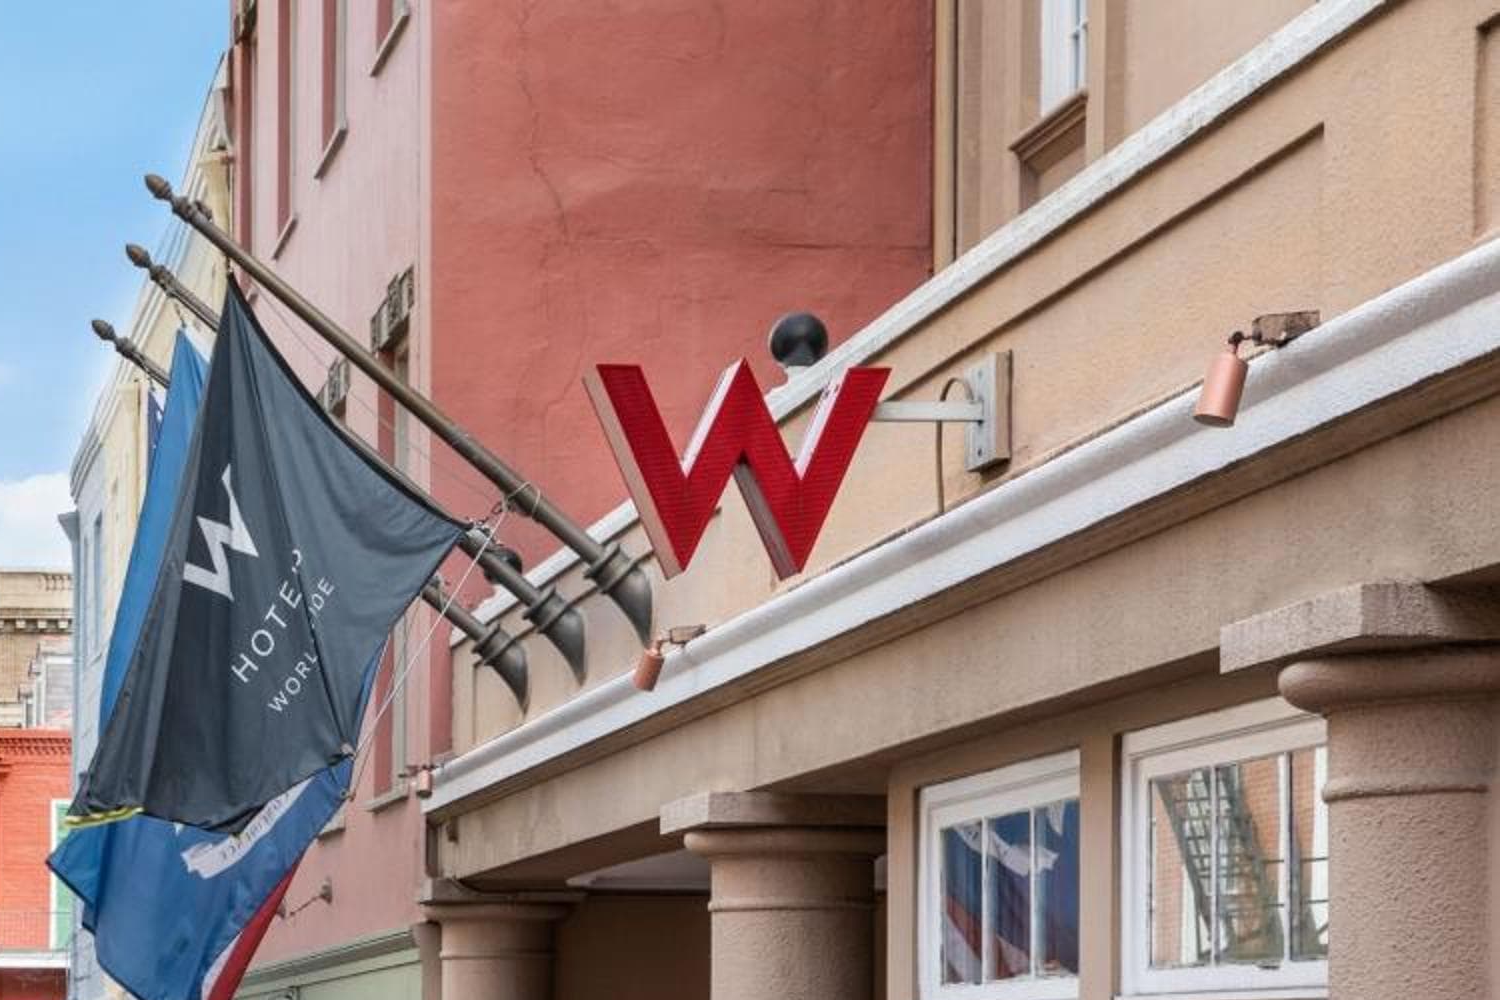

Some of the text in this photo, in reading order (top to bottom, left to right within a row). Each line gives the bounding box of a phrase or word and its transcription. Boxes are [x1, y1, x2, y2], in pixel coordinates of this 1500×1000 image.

[183, 463, 259, 602] W
[582, 357, 893, 582] W
[231, 548, 303, 683] HOTE
[267, 577, 335, 712] WORLIDE
